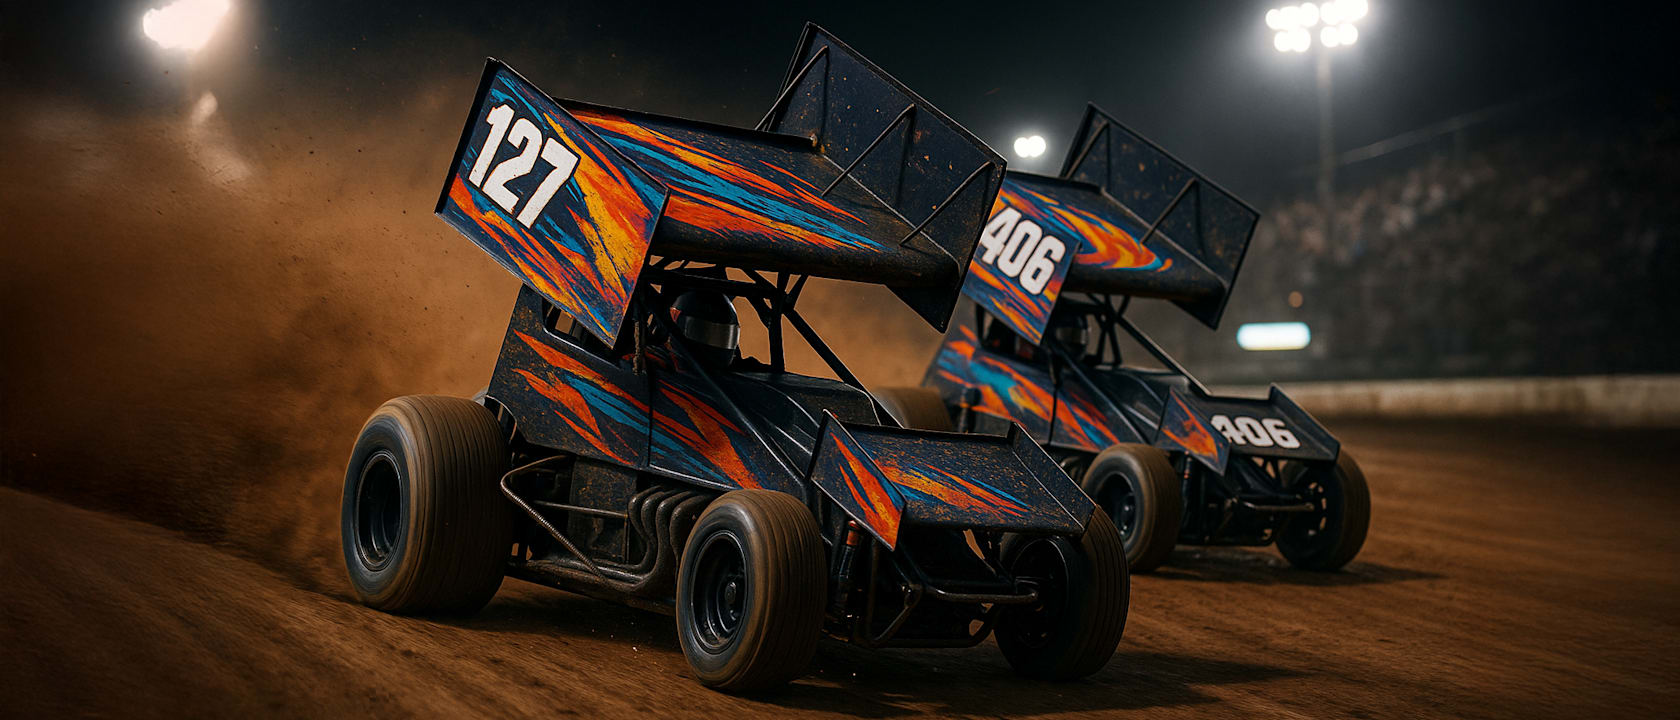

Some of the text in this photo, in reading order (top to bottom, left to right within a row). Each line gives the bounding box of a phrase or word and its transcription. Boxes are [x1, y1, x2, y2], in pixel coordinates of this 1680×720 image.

[468, 104, 578, 229] 127
[979, 207, 1066, 295] 406
[1210, 415, 1300, 448] 406
